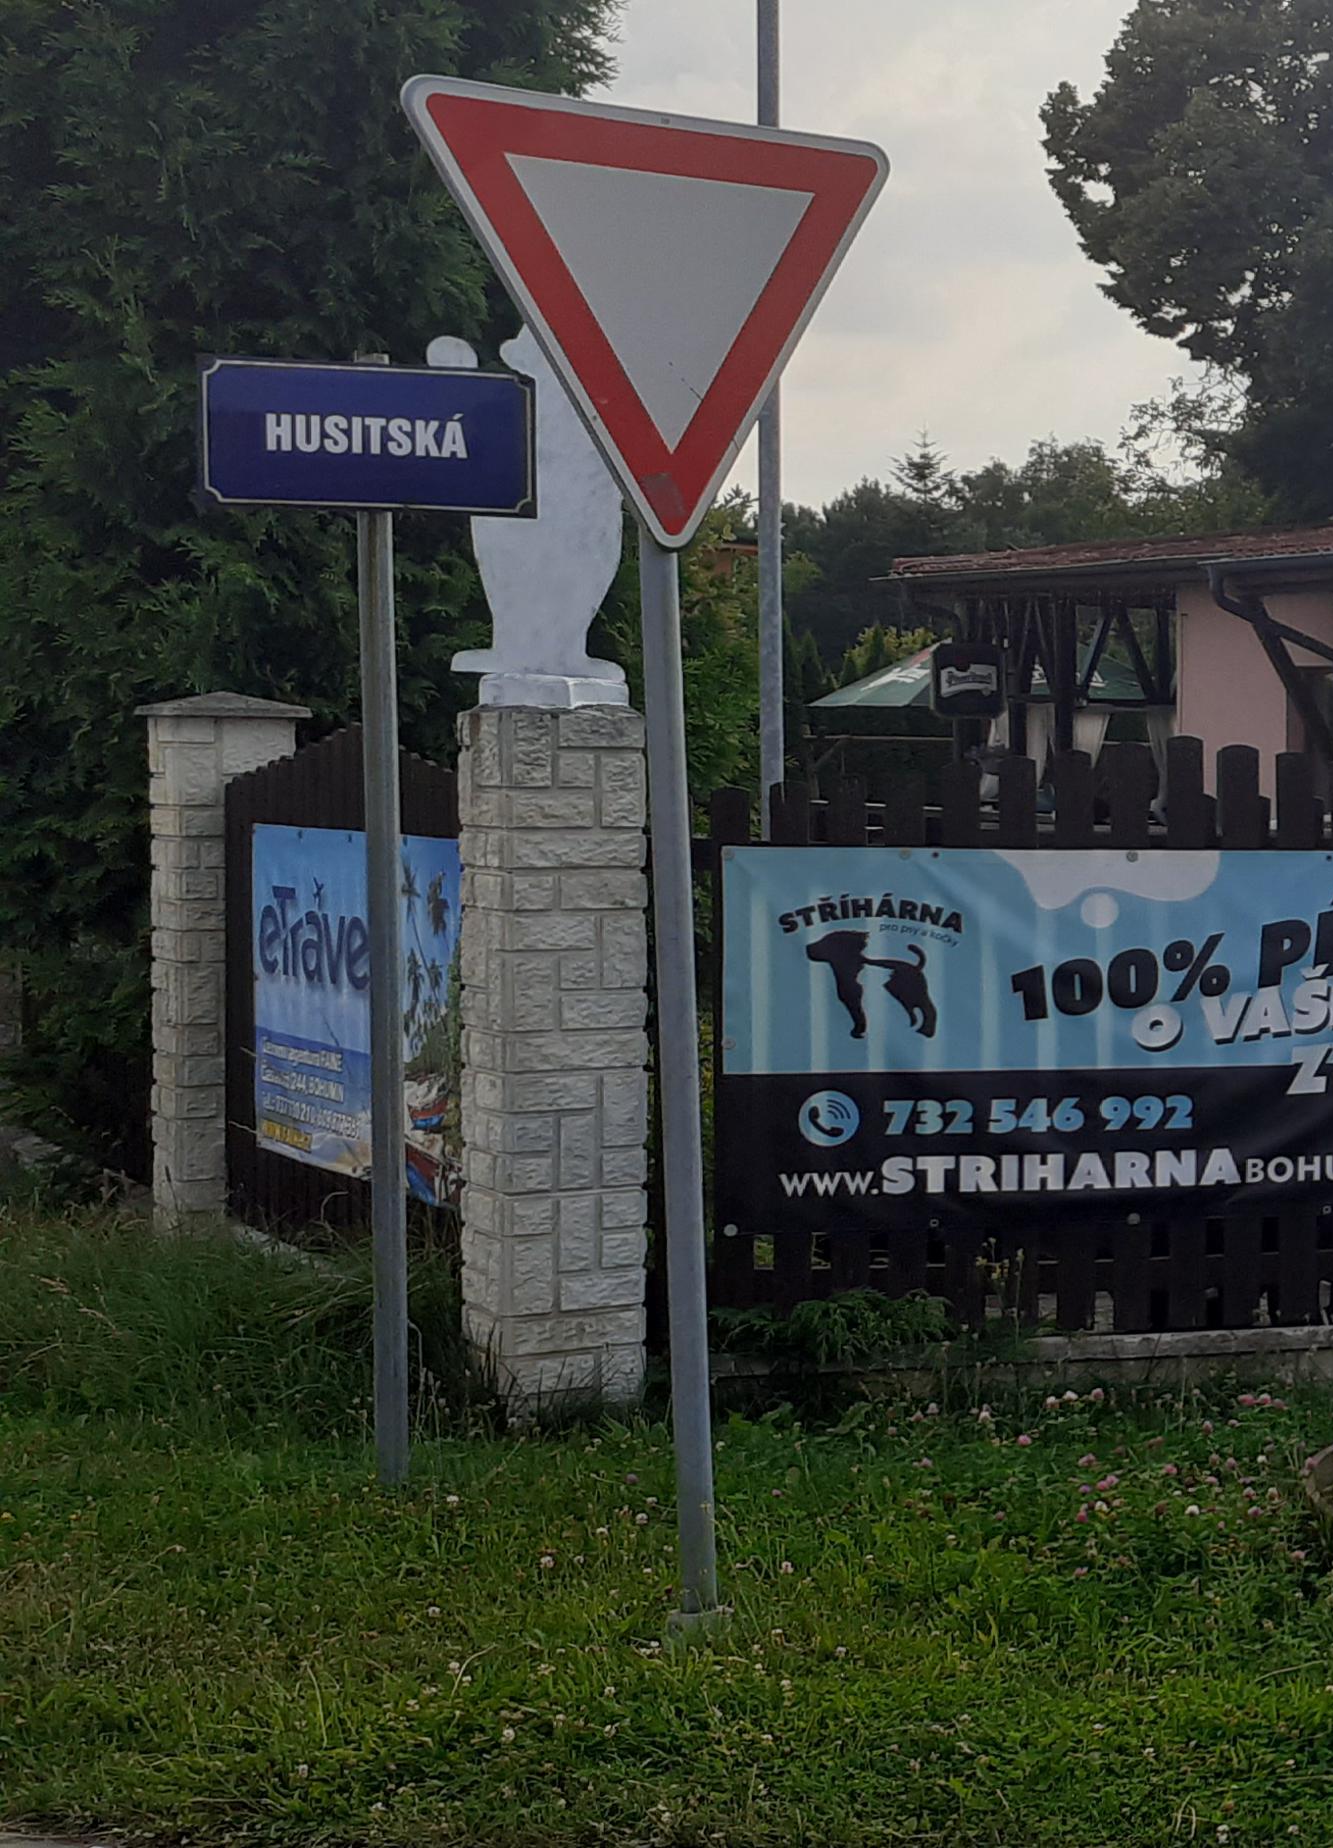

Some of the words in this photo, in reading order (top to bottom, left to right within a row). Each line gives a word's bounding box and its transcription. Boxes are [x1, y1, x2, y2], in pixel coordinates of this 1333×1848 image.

[265, 413, 468, 459] HUSITSKÁ
[778, 892, 963, 934] STŘÍHÁRNA
[258, 886, 371, 990] eTrave
[1010, 932, 1231, 1021] 100%
[883, 1099, 974, 1135] 732
[988, 1097, 1085, 1134] 546
[1100, 1095, 1193, 1131] 992
